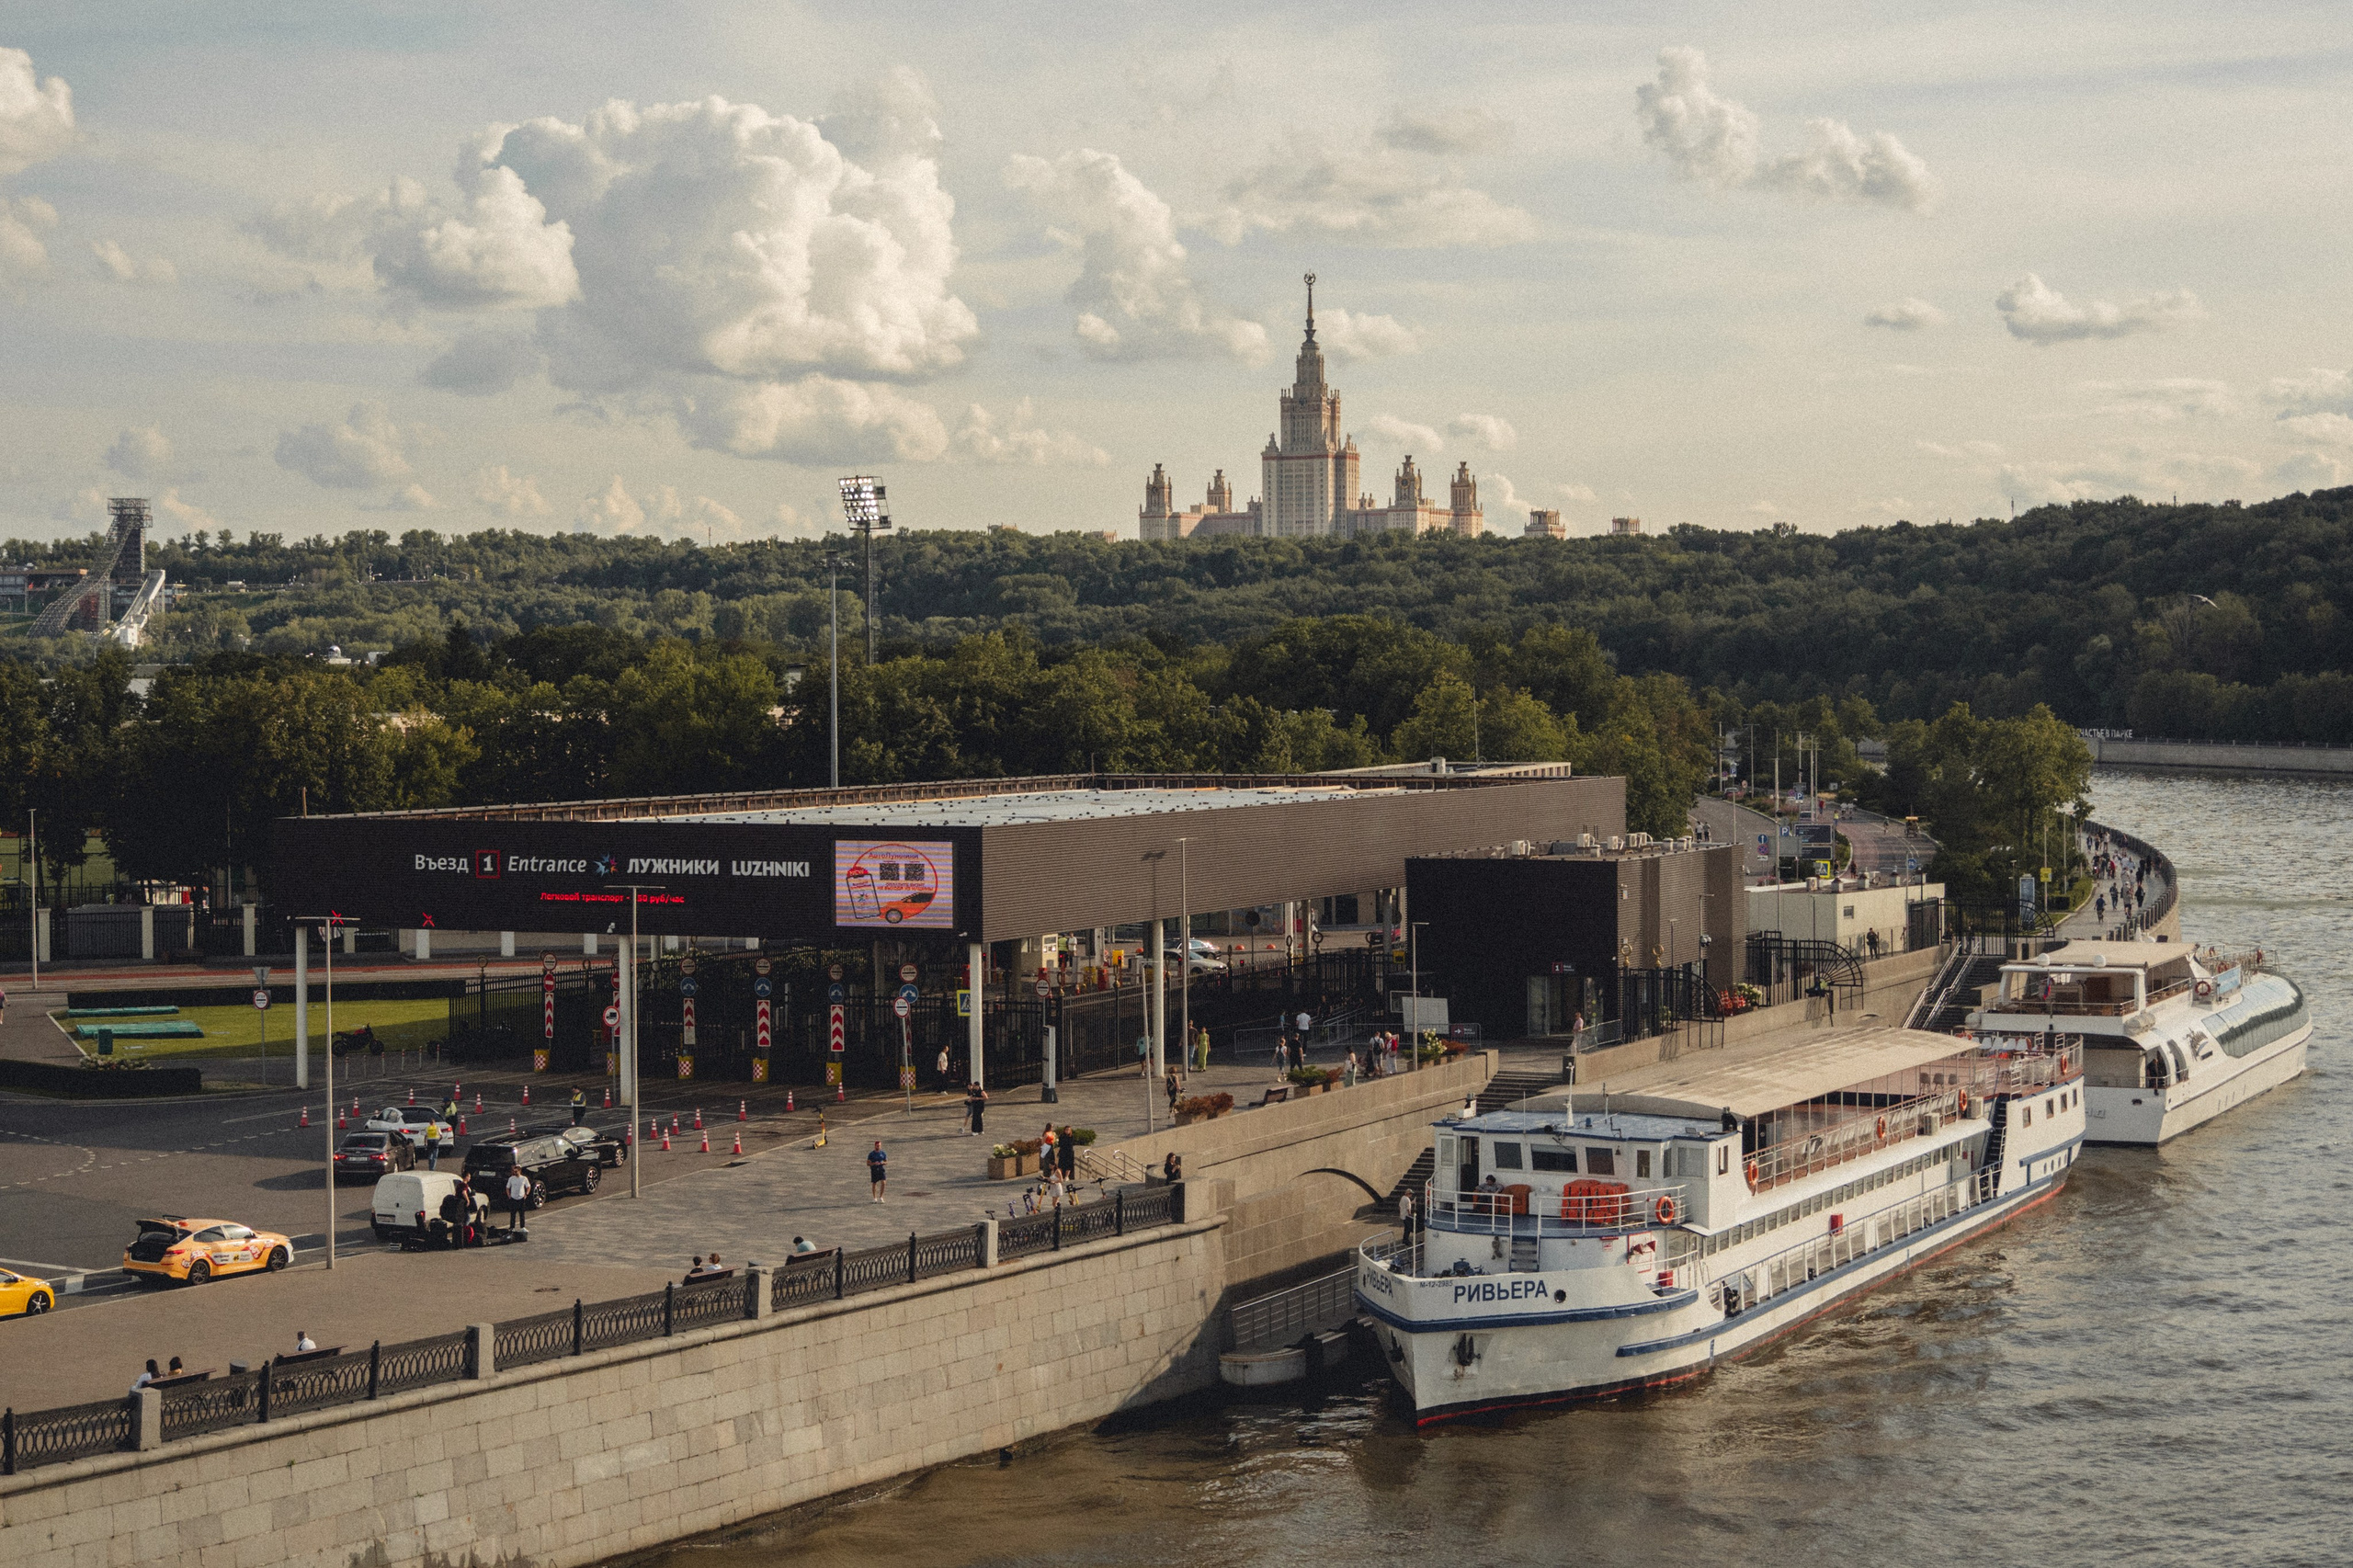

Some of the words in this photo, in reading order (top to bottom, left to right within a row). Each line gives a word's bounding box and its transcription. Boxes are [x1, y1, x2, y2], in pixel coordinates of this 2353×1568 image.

[2076, 728, 2104, 738] ЧАСТЬЕ
[2111, 728, 2133, 738] ПАРКЕ
[1781, 827, 1789, 835] P
[415, 854, 469, 873] Въезд
[483, 855, 494, 871] 1
[507, 856, 587, 872] Entrance
[627, 858, 720, 875] ЛУЖНИКИ
[732, 860, 810, 877] LUZHNIKI
[540, 892, 580, 901] Легковой
[582, 894, 624, 903] транспорт
[649, 893, 685, 903] руб/час
[1454, 1280, 1548, 1303] РИВЬЕРА
